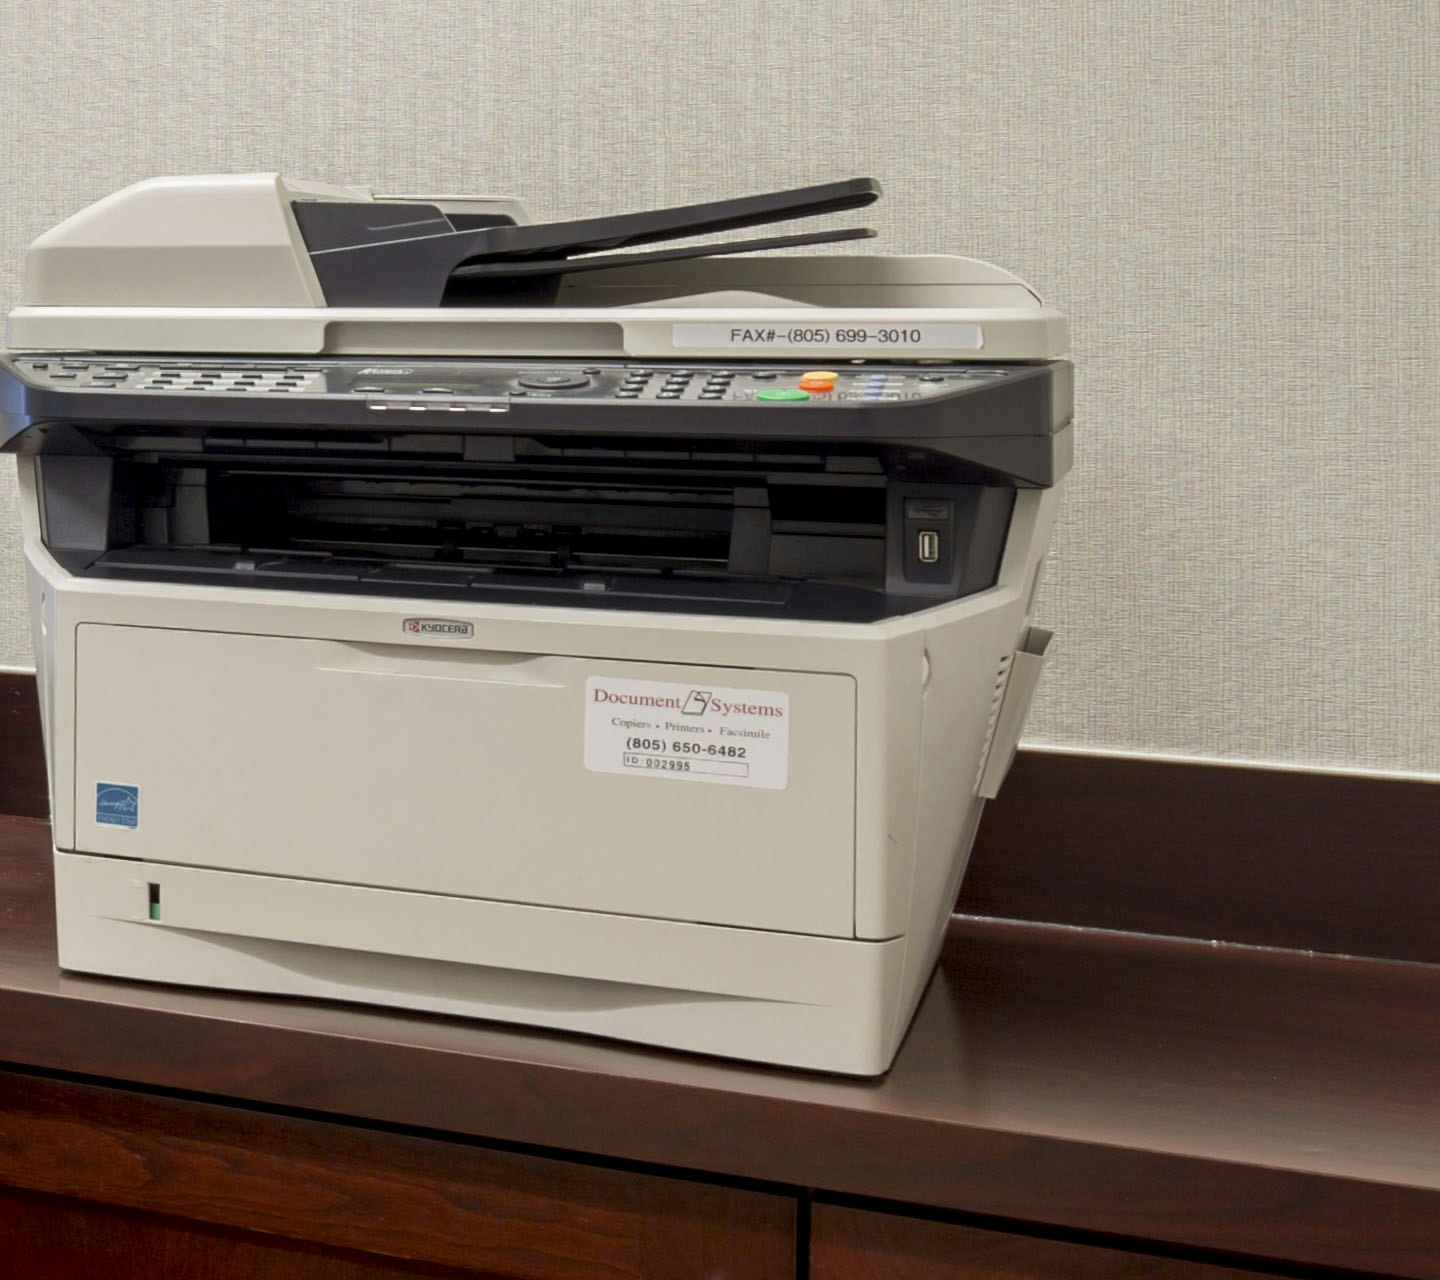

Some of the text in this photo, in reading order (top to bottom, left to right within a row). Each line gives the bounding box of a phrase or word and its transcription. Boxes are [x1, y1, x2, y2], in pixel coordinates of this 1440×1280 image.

[835, 328, 921, 343] 699-3010
[420, 623, 468, 634] KYOCERA
[593, 688, 784, 718] Document Systems
[611, 716, 771, 740] Copiers Printers Facsimile
[626, 737, 747, 759] (805) 650-6482
[646, 758, 691, 771] 002995
